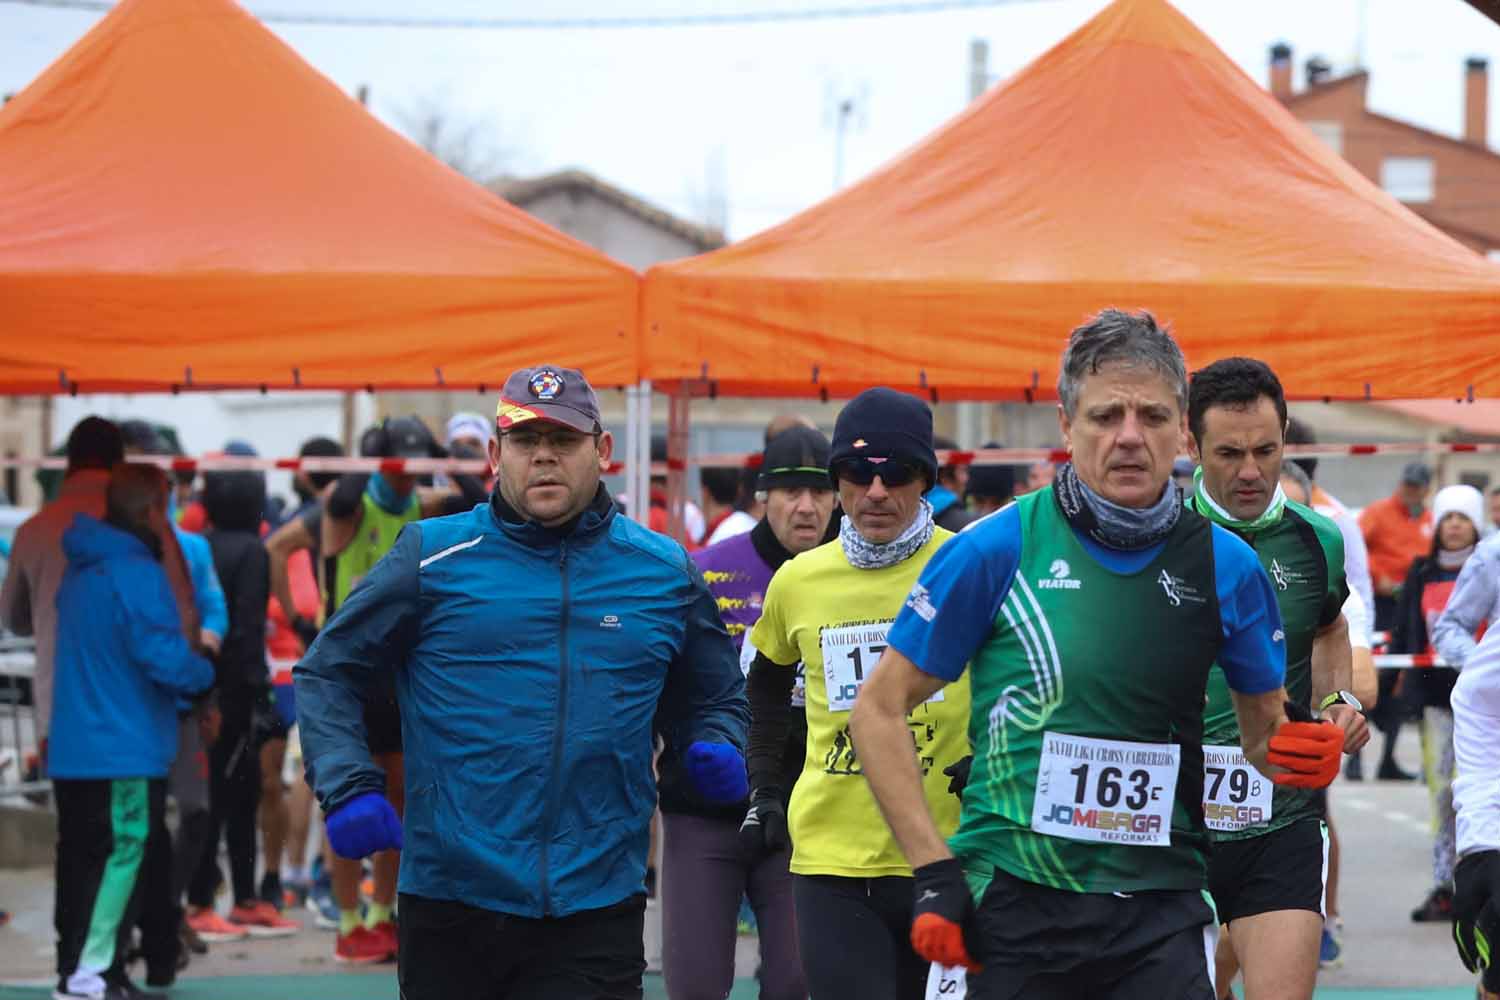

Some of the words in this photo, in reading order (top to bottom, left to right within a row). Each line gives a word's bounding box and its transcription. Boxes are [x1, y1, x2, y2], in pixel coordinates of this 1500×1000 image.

[1038, 579, 1081, 590] VIATOR
[1074, 743, 1094, 760] LIGA
[1096, 745, 1124, 763] CROSS
[1125, 749, 1175, 767] CARRERIZOS
[1205, 752, 1225, 765] ROSS
[1070, 763, 1150, 811] 163
[1206, 767, 1249, 804] 79
[1042, 803, 1162, 833] JOMISAGA
[1100, 831, 1159, 843] REFORMAS
